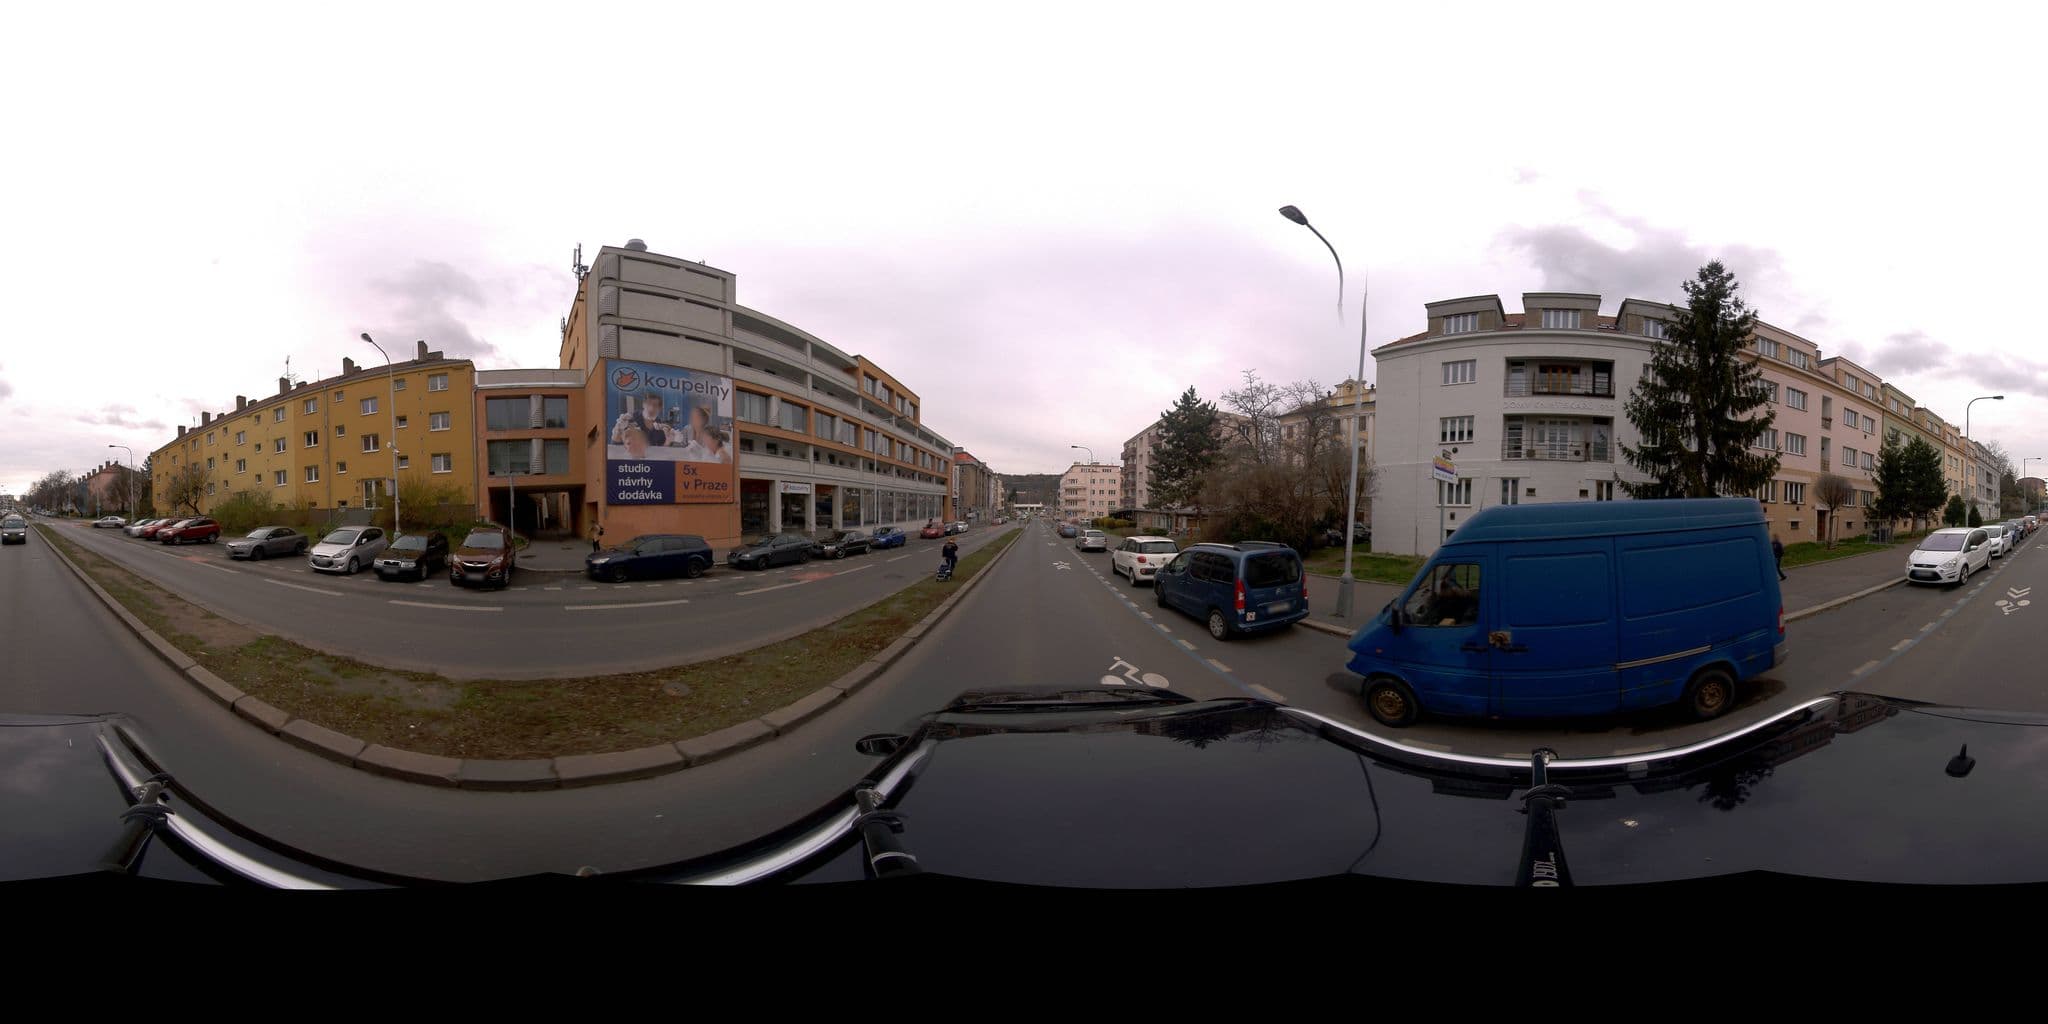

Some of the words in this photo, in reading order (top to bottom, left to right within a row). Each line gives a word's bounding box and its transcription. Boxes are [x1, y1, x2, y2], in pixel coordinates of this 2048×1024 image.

[644, 371, 729, 400] koupelny
[618, 463, 651, 473] studio
[683, 465, 698, 475] 5x
[618, 477, 653, 488] návrhy
[683, 482, 690, 490] v
[694, 480, 728, 491] Praze
[618, 490, 662, 500] dodávka
